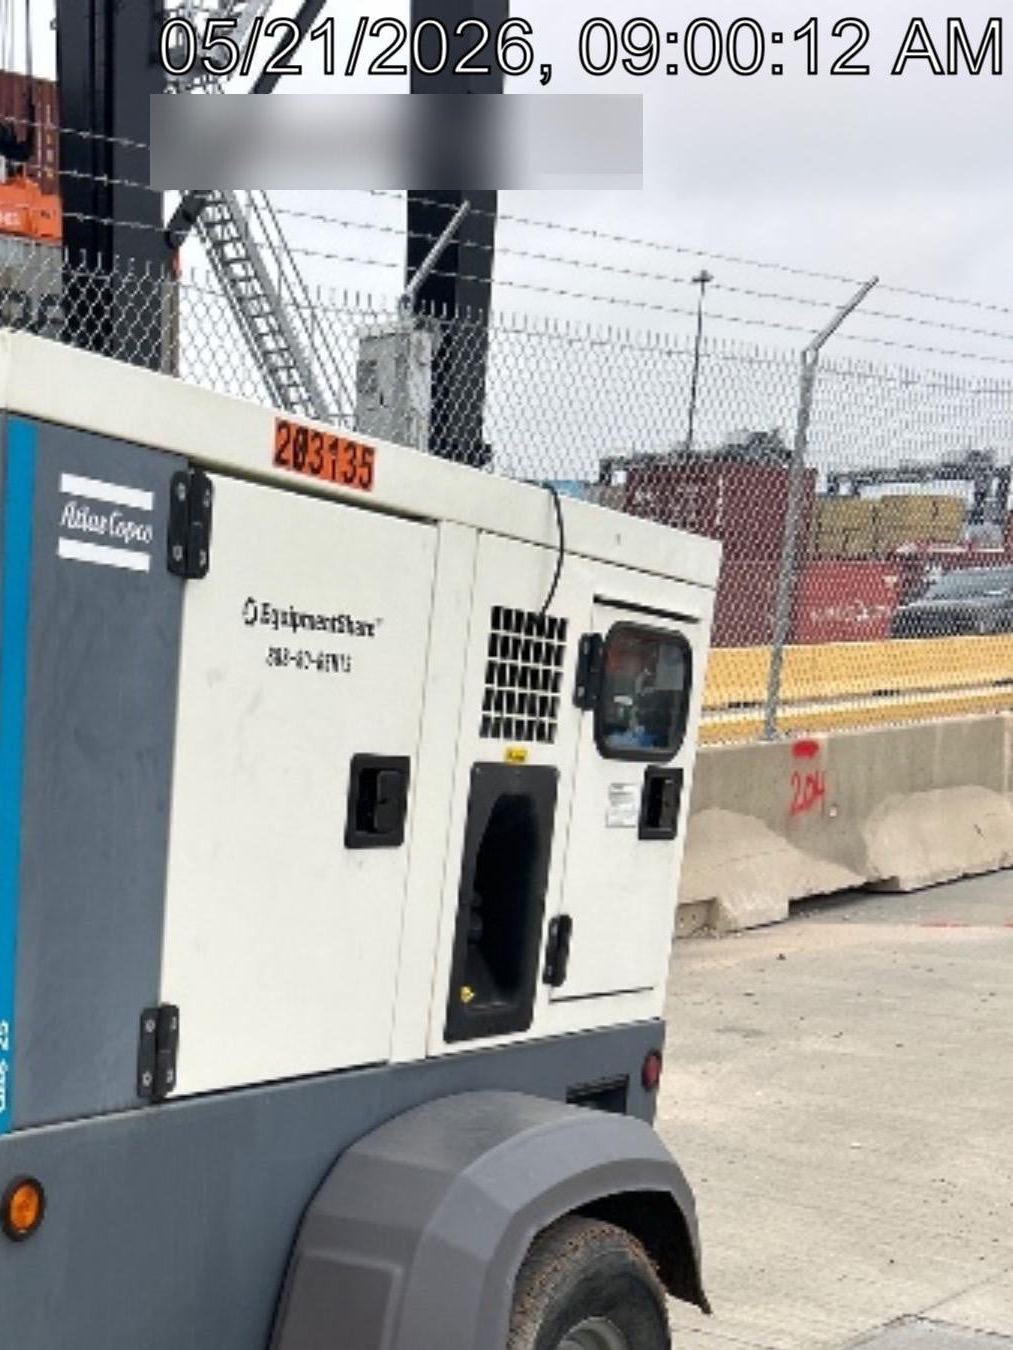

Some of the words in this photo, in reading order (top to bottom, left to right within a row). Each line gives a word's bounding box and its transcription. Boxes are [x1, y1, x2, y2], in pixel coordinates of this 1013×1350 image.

[274, 420, 375, 491] 203135
[60, 501, 109, 534] Atlas
[110, 510, 153, 544] Copco
